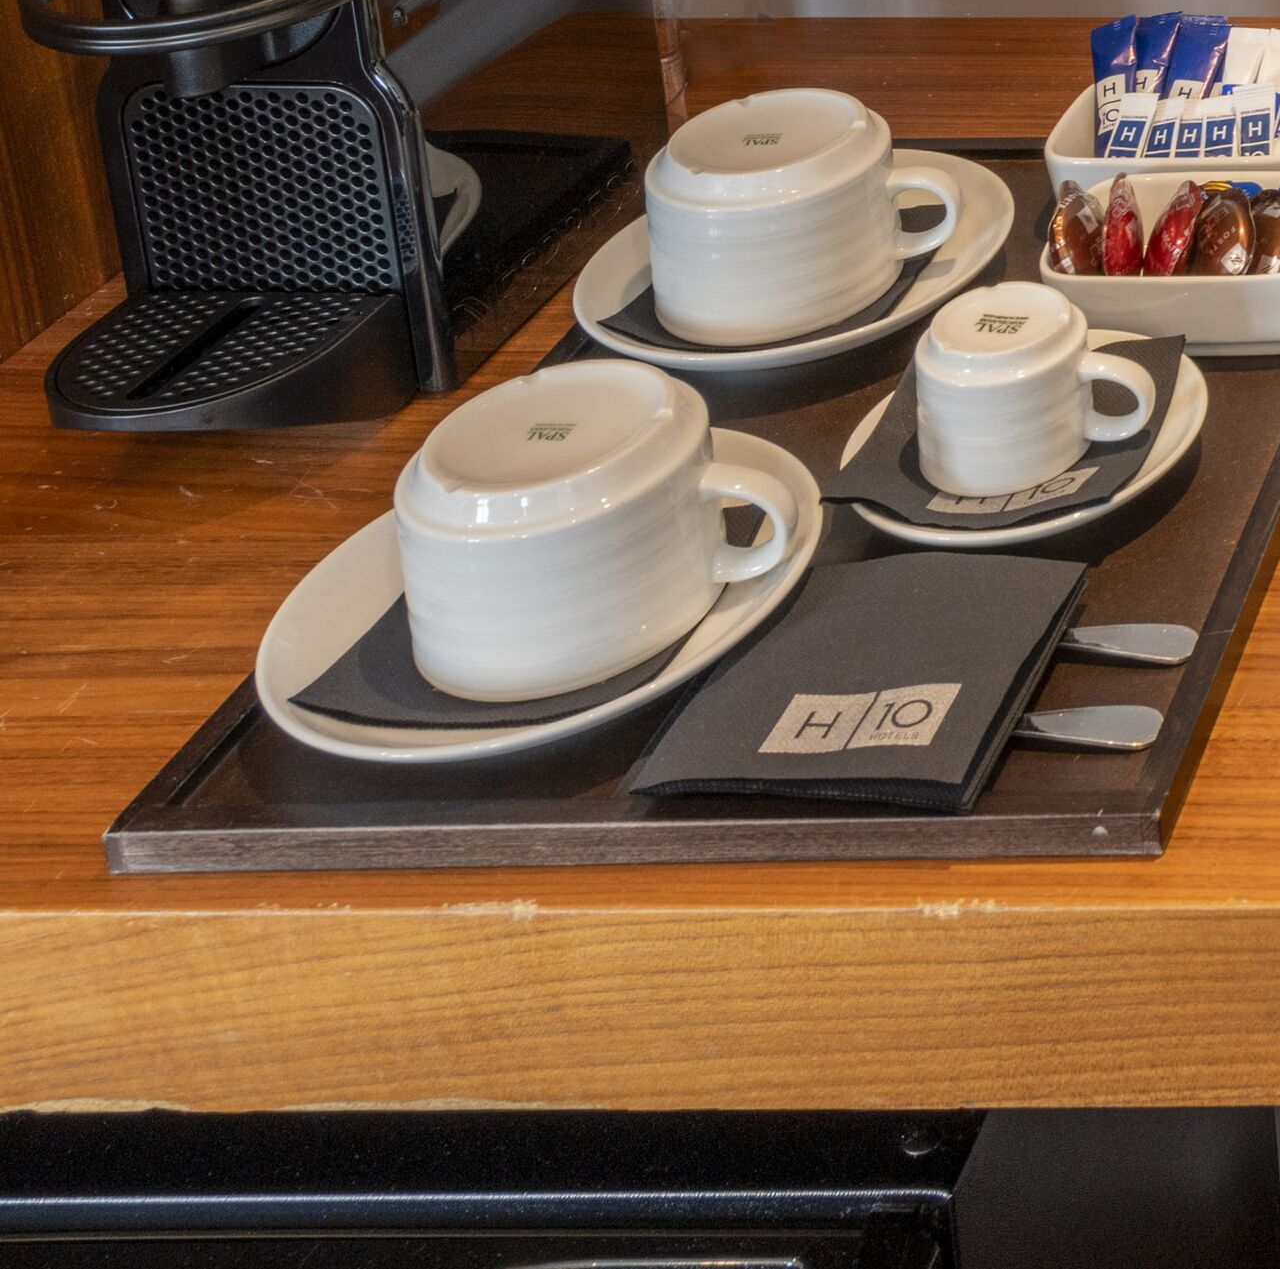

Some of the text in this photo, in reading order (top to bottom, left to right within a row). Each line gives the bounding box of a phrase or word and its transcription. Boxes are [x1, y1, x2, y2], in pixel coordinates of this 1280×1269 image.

[1103, 82, 1117, 98] H
[1120, 126, 1137, 142] H
[1153, 128, 1168, 146] H
[1182, 128, 1198, 144] H
[1212, 125, 1227, 141] H
[1248, 121, 1263, 138] H
[974, 322, 1022, 334] SPAL
[794, 699, 933, 740] H 10
[868, 731, 921, 741] HOTELS
